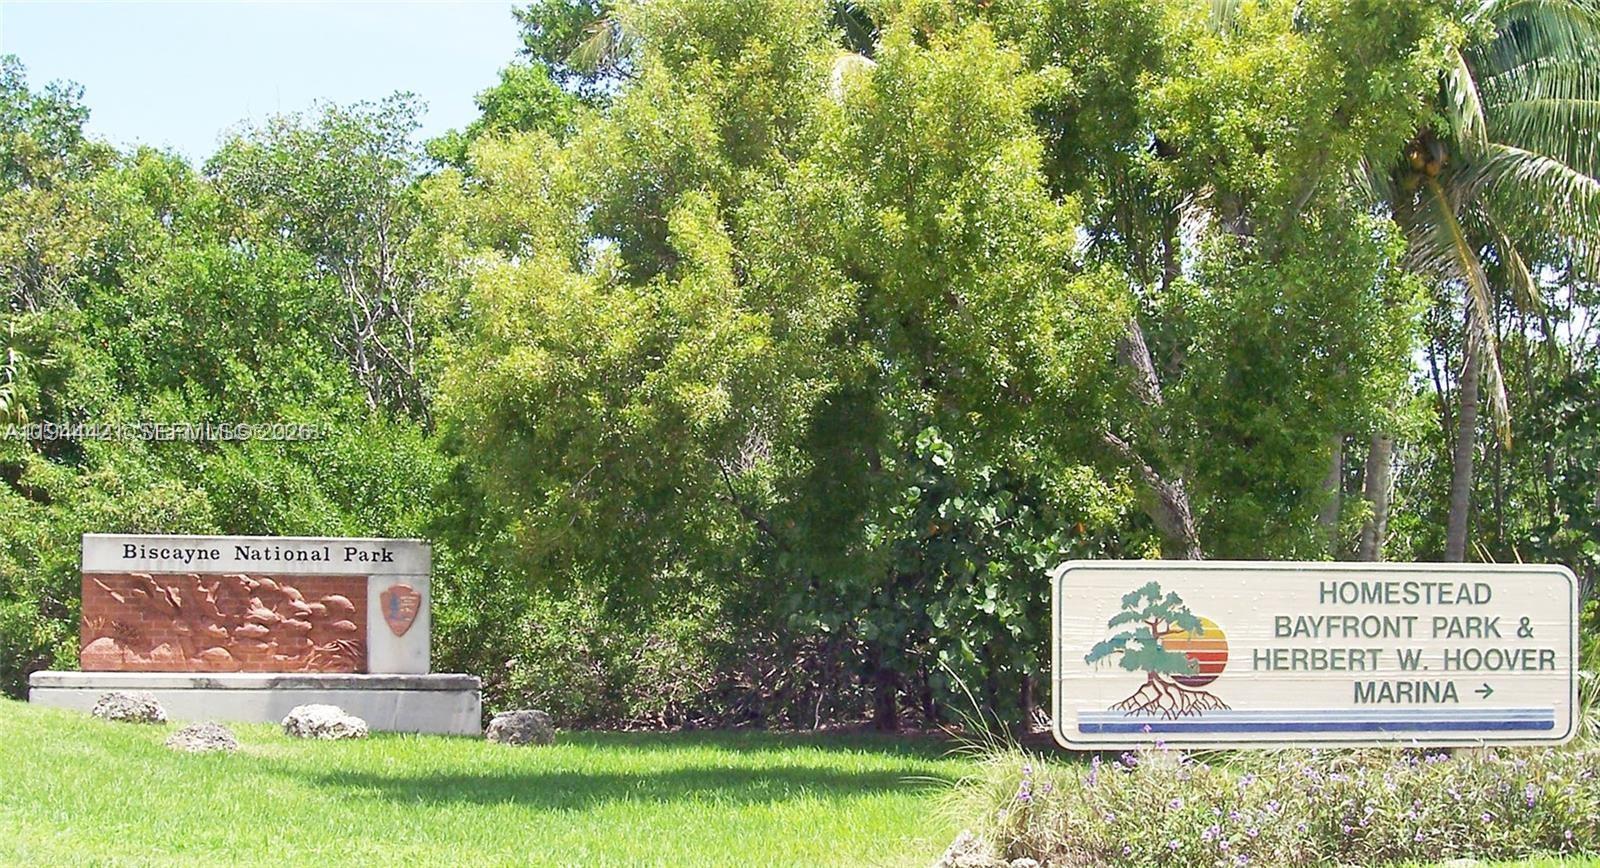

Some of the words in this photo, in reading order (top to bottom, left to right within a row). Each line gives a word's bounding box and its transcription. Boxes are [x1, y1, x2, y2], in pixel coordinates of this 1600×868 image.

[123, 543, 220, 564] Biscayne
[234, 545, 330, 561] National
[343, 547, 394, 562] Park
[1319, 581, 1492, 605] HOMESTEAD
[1275, 615, 1419, 639] BAYFRONT
[1432, 616, 1502, 639] PARK
[1516, 616, 1534, 639] &
[1252, 648, 1383, 671] HERBERT
[1396, 648, 1428, 671] W.
[1444, 648, 1556, 671] HOOVER
[1353, 681, 1459, 704] MARINA
